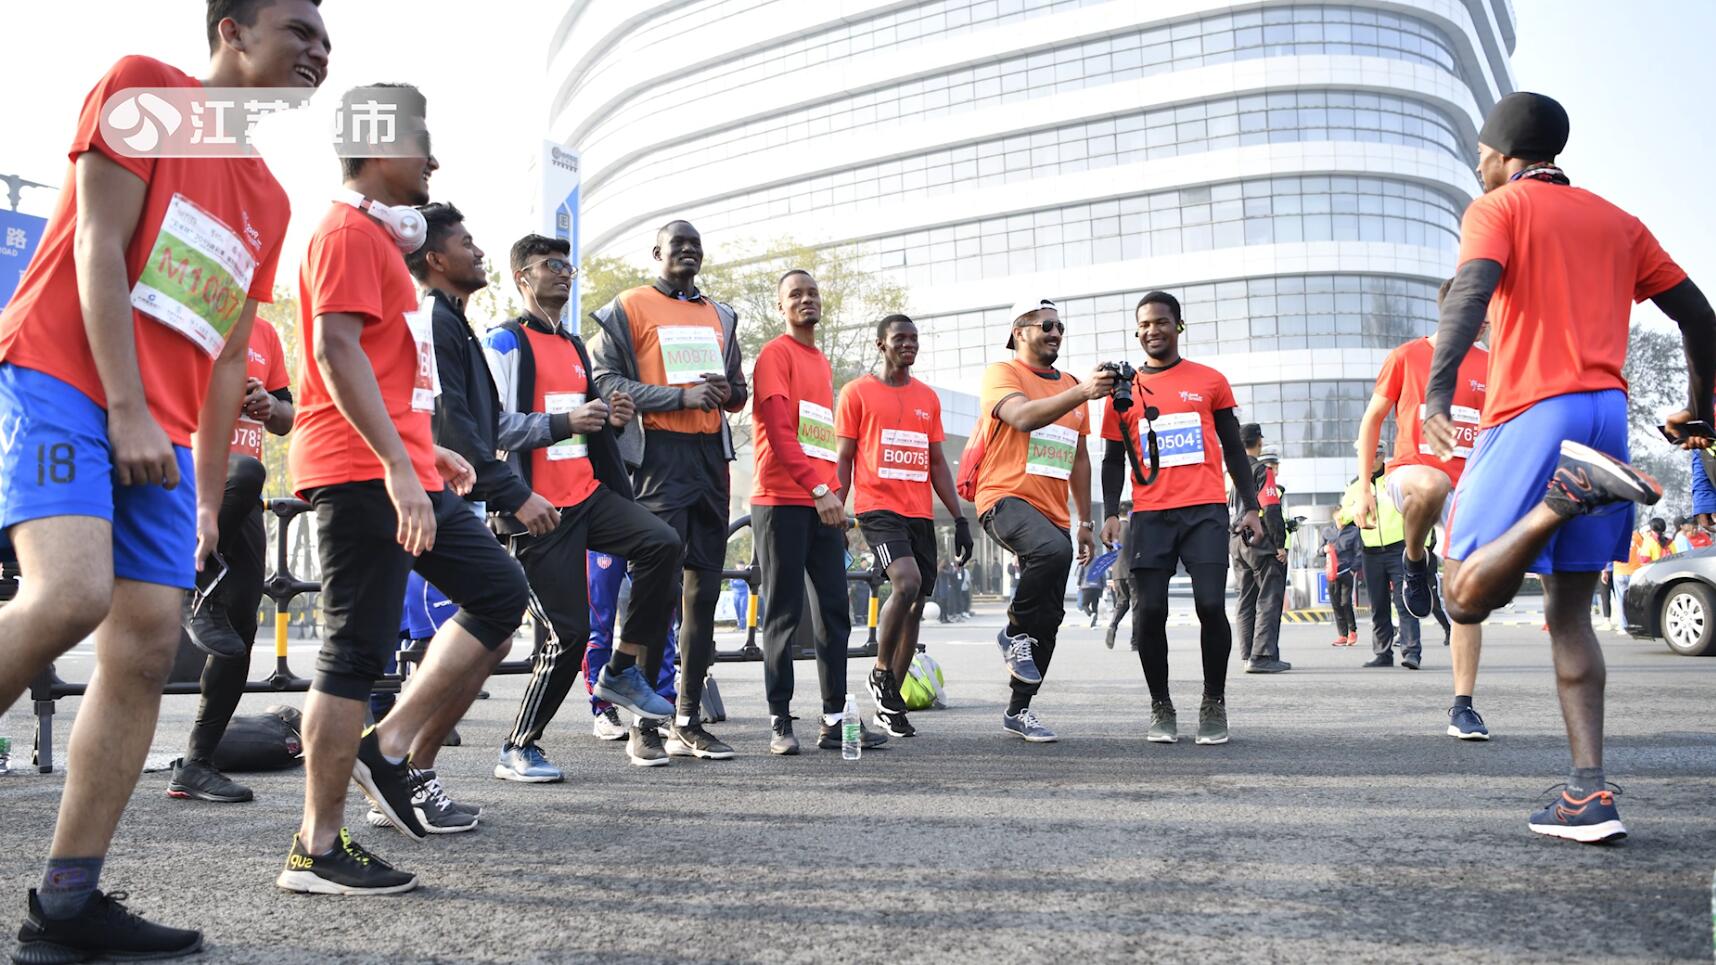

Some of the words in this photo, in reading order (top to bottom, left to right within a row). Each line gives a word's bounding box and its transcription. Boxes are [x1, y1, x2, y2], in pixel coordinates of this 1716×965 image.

[6, 227, 27, 249] 路
[36, 442, 76, 487] 18
[884, 448, 925, 466] B0075
